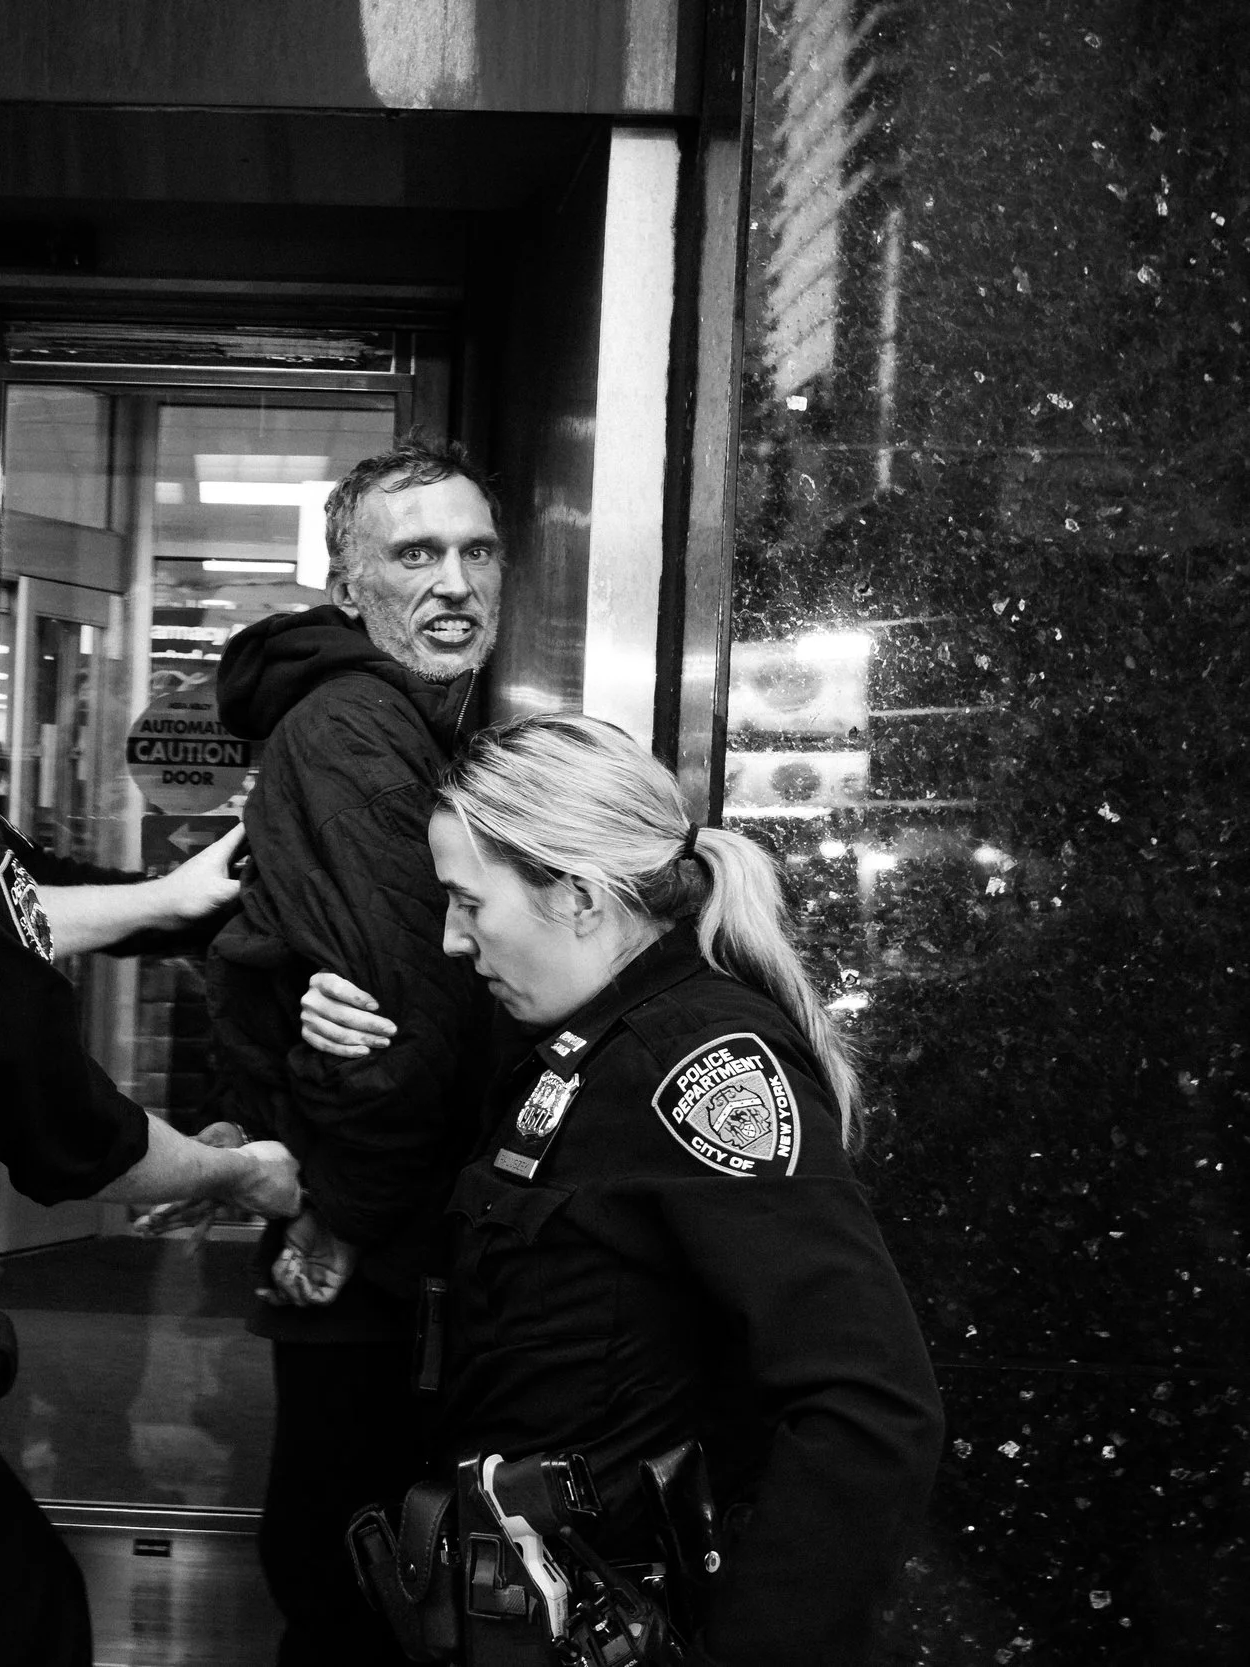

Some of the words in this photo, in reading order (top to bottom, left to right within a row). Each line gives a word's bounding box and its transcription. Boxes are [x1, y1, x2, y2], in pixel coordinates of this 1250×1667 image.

[135, 741, 244, 765] CAUTION
[162, 770, 214, 785] DOOR
[676, 1047, 735, 1092] POLICE
[672, 1055, 765, 1124] DEPARTMENT
[769, 1076, 791, 1119] YORK
[691, 1136, 728, 1162] CITY
[777, 1122, 792, 1157] NEW
[729, 1157, 756, 1171] OF
